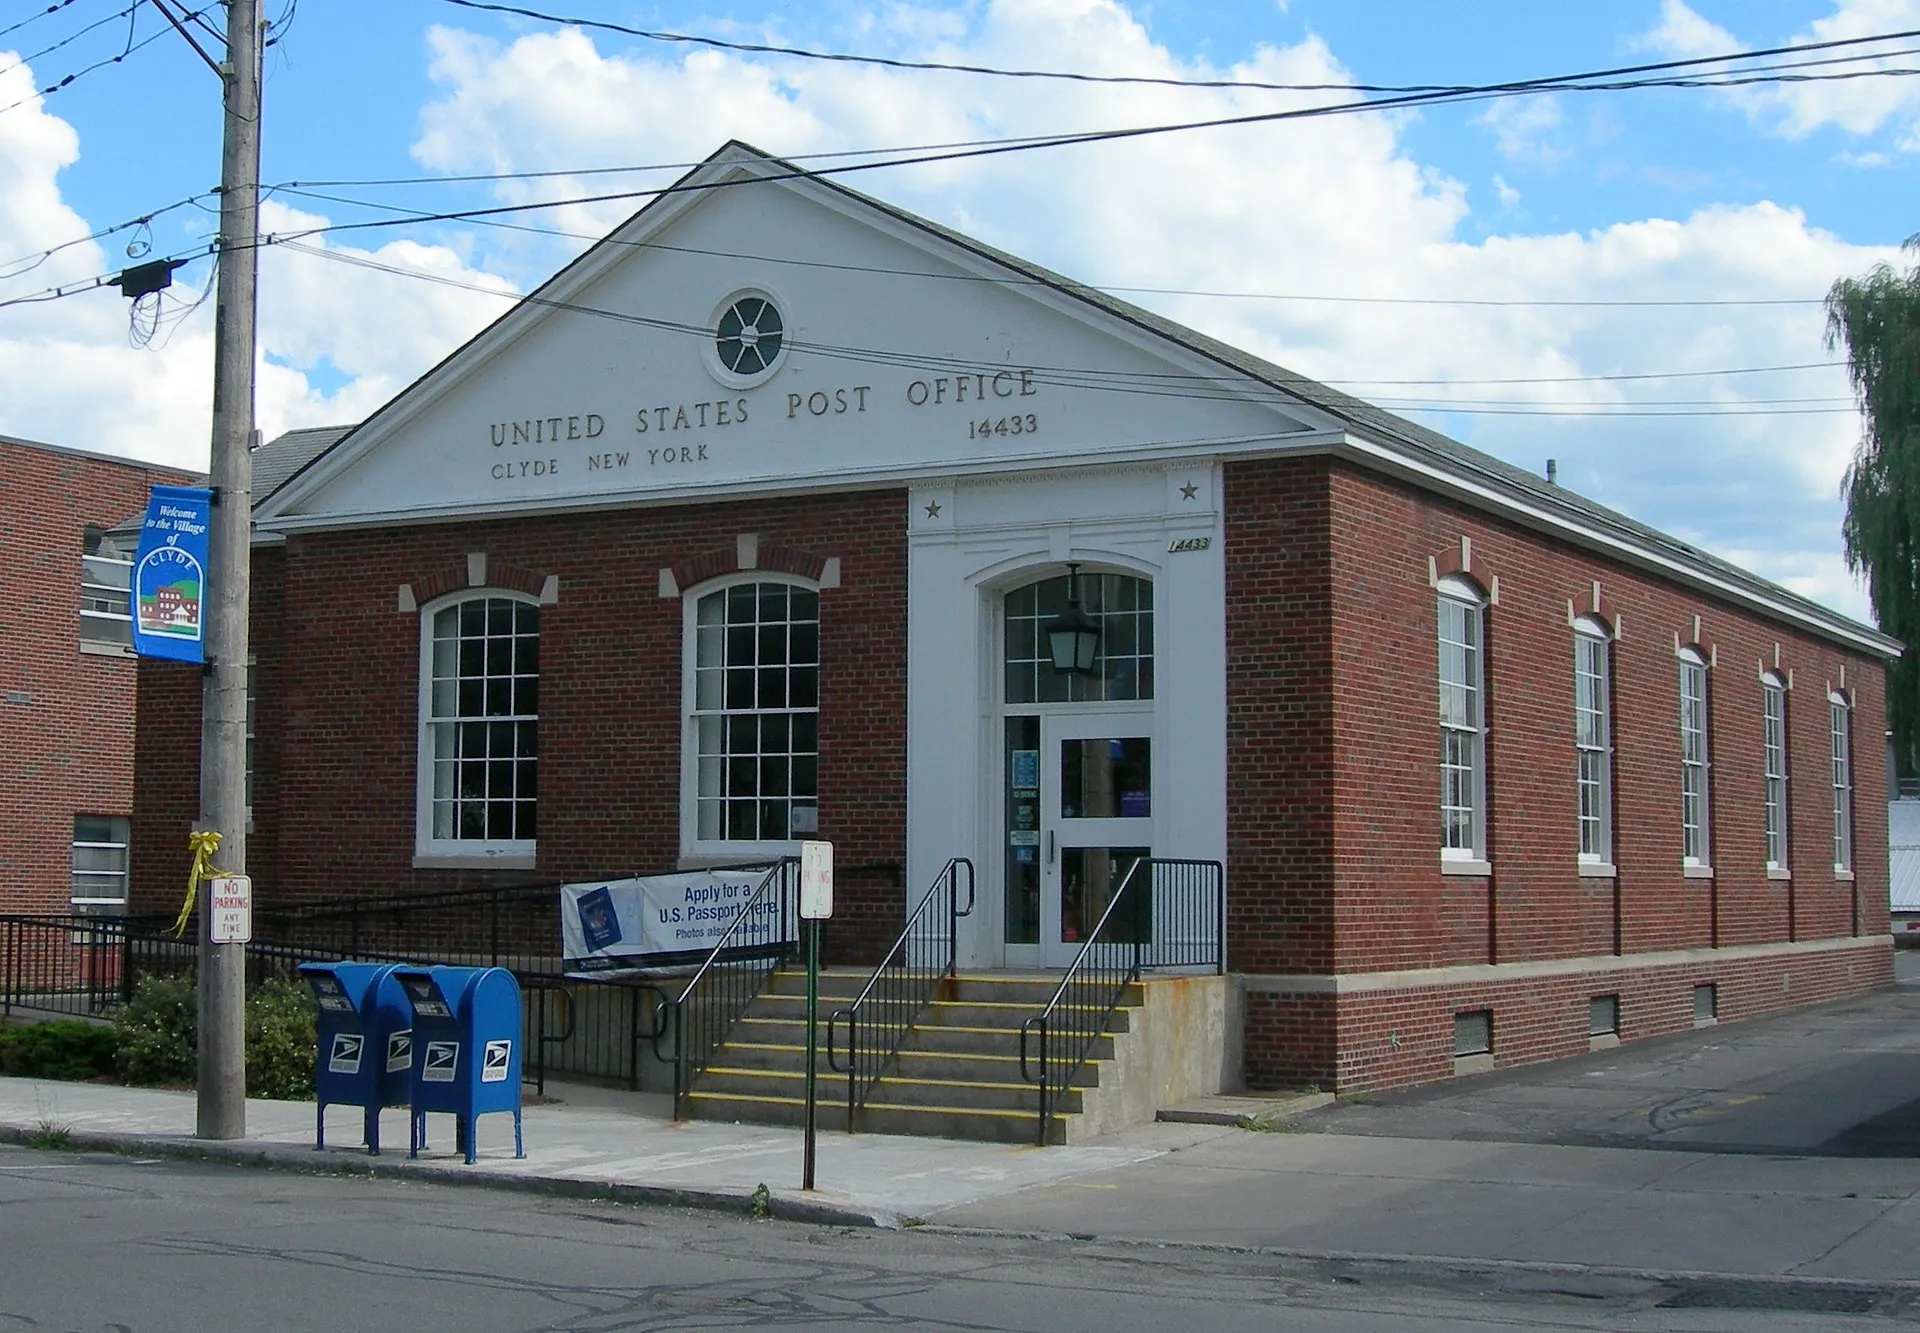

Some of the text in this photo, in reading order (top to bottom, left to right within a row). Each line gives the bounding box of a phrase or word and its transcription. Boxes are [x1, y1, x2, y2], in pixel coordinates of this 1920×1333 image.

[491, 370, 1037, 447] UNITED STATES POST OFFICE
[969, 414, 1038, 440] 14433
[491, 445, 708, 480] CLYDE NEW YORK
[160, 505, 198, 519] Welcome
[146, 518, 206, 536] to the Village
[166, 533, 180, 546] of
[1170, 537, 1209, 550] 14433
[149, 550, 194, 570] CLYDE
[224, 882, 239, 894] NO
[684, 883, 751, 904] Apply for a
[214, 896, 248, 909] PARKING
[224, 913, 239, 922] ANY
[660, 907, 684, 923] U.S.
[687, 902, 741, 921] Passport
[222, 923, 241, 933] TIME
[676, 928, 704, 939] Photos
[707, 925, 726, 937] also
